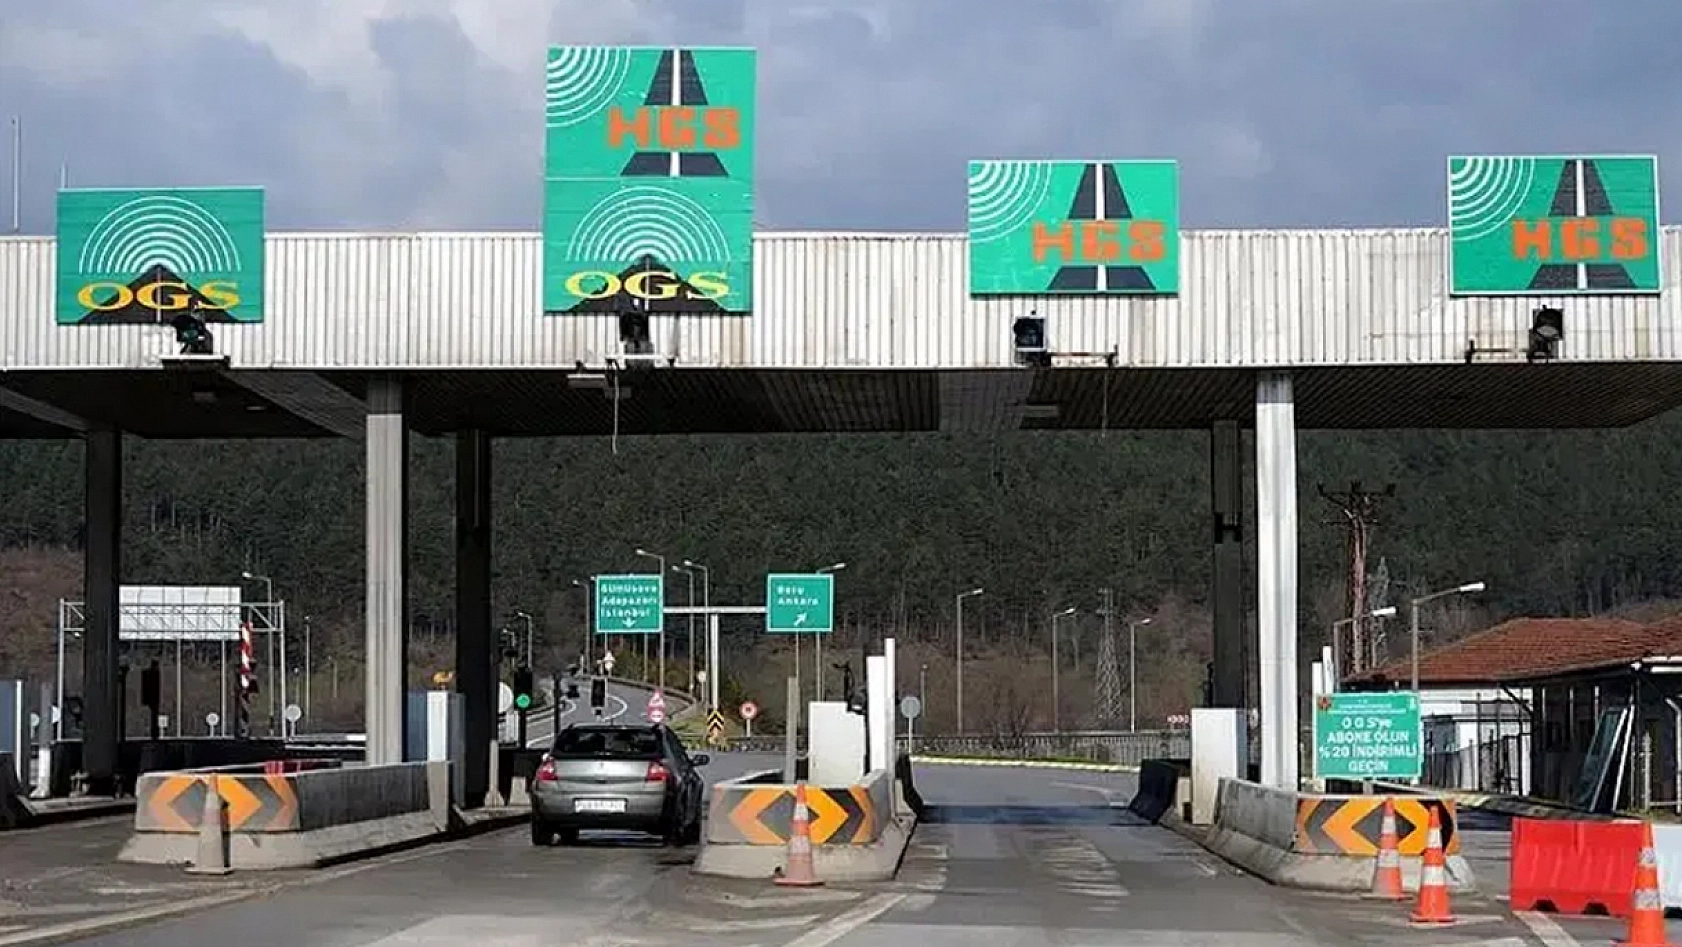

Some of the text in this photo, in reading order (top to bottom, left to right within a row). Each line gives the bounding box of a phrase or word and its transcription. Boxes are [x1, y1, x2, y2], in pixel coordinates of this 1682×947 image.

[607, 106, 741, 148] HGS
[1032, 220, 1167, 263] HGS
[1512, 217, 1648, 260] HGS
[77, 281, 241, 310] OGS
[564, 271, 730, 299] OGS
[1327, 730, 1410, 743] ABONE OLUN
